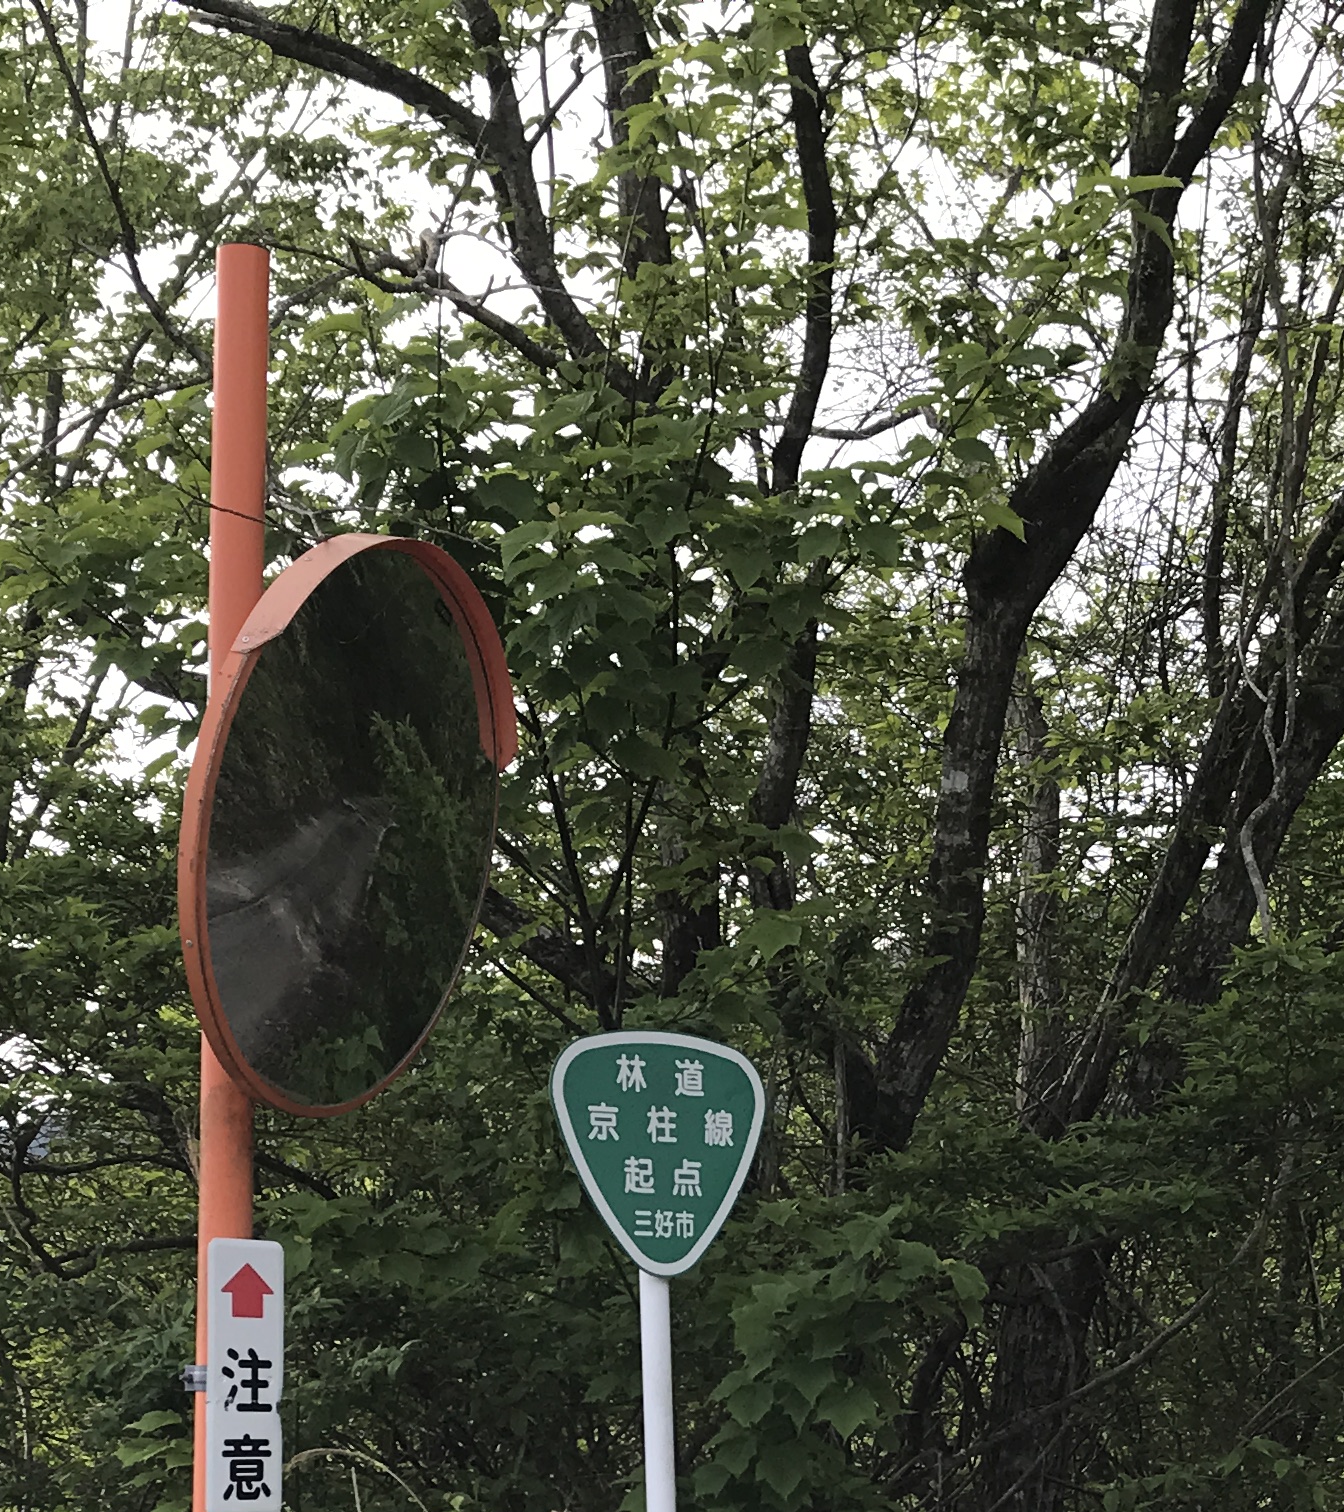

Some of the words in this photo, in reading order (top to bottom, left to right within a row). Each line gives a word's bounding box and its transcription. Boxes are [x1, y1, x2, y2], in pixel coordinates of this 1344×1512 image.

[616, 1054, 705, 1097] 林道
[587, 1102, 734, 1147] 京柱線
[623, 1156, 702, 1197] 起点
[634, 1209, 694, 1239] 三好市
[221, 1347, 273, 1501] 注意
